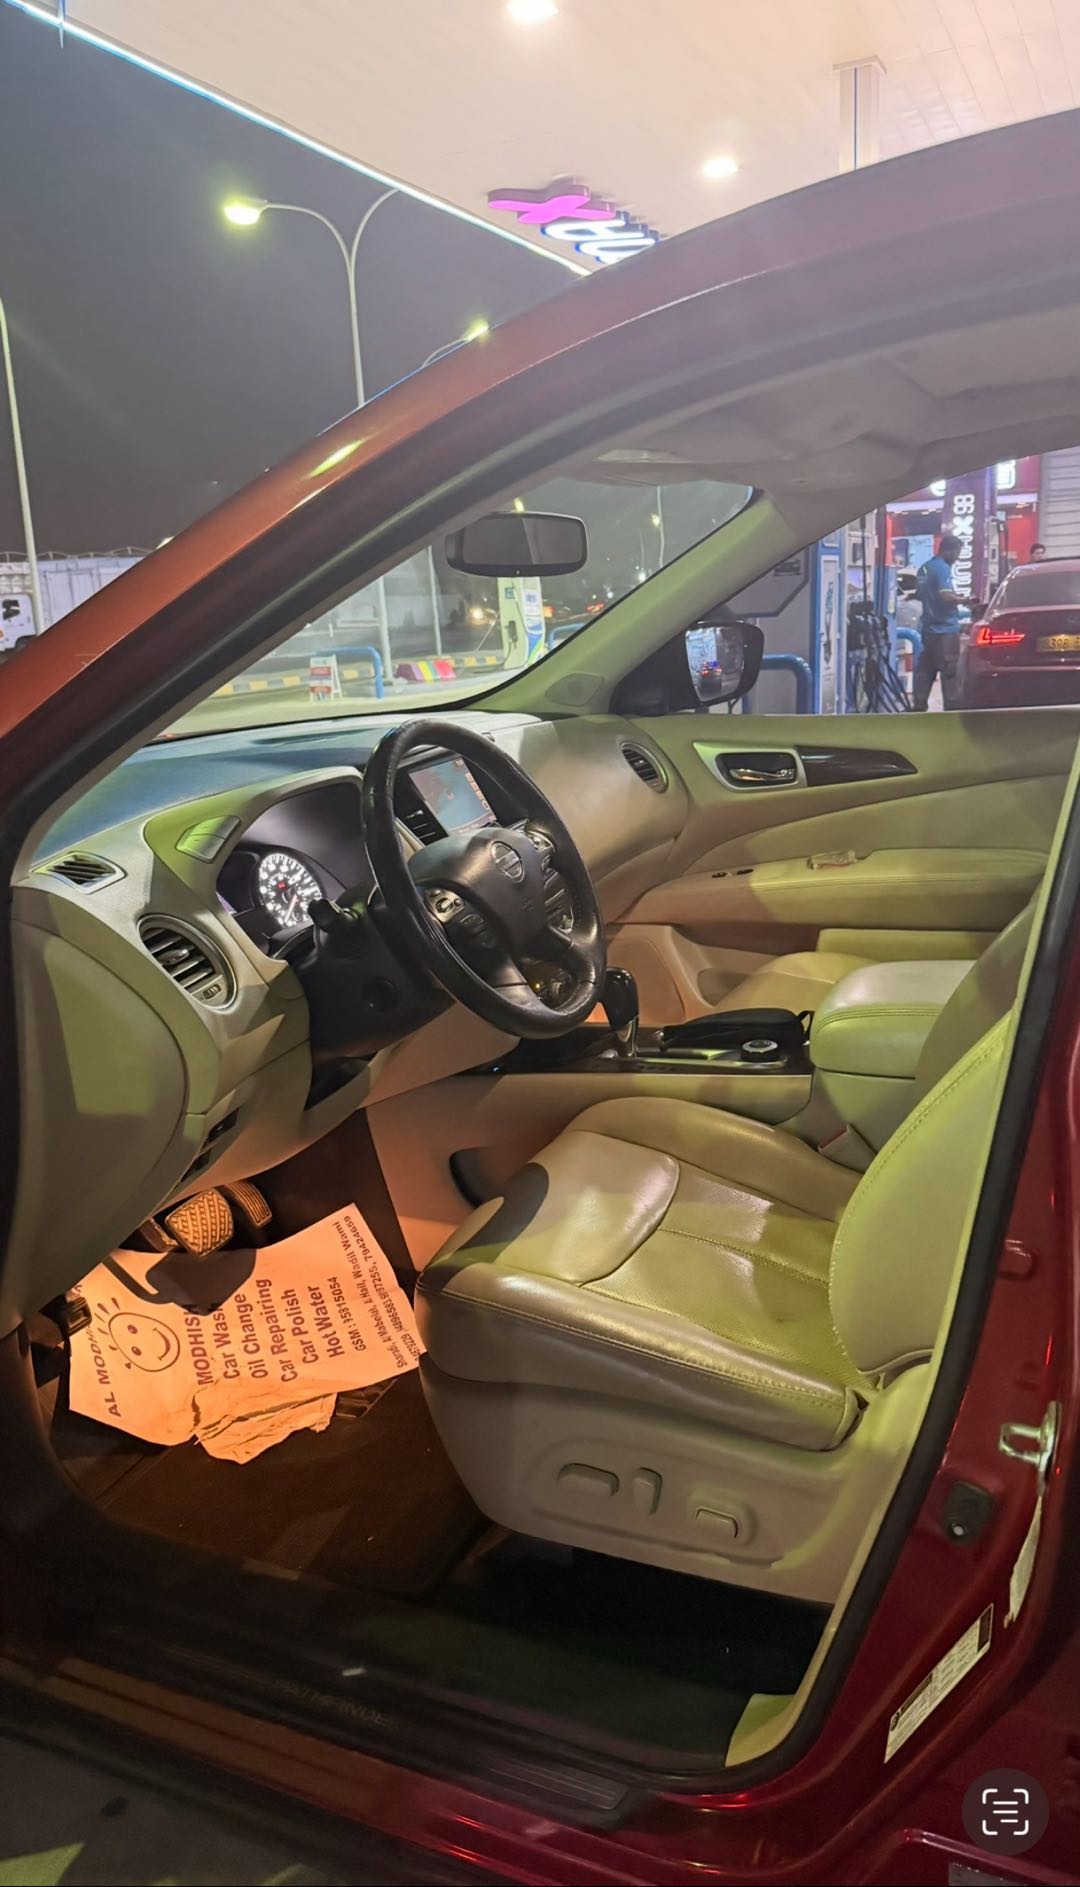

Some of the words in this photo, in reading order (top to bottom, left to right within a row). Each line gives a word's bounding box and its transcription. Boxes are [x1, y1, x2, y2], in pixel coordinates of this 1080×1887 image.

[256, 1279, 288, 1355] Repairing
[281, 1289, 309, 1337] Polish
[307, 1286, 333, 1332] Water
[234, 1294, 261, 1355] Change
[300, 1340, 319, 1364] Car
[322, 1331, 345, 1358] Hot
[348, 1328, 367, 1351] GSM
[223, 1353, 240, 1379] Car
[248, 1359, 269, 1379] Oil
[279, 1360, 298, 1382] Car
[104, 1391, 121, 1417] AL
